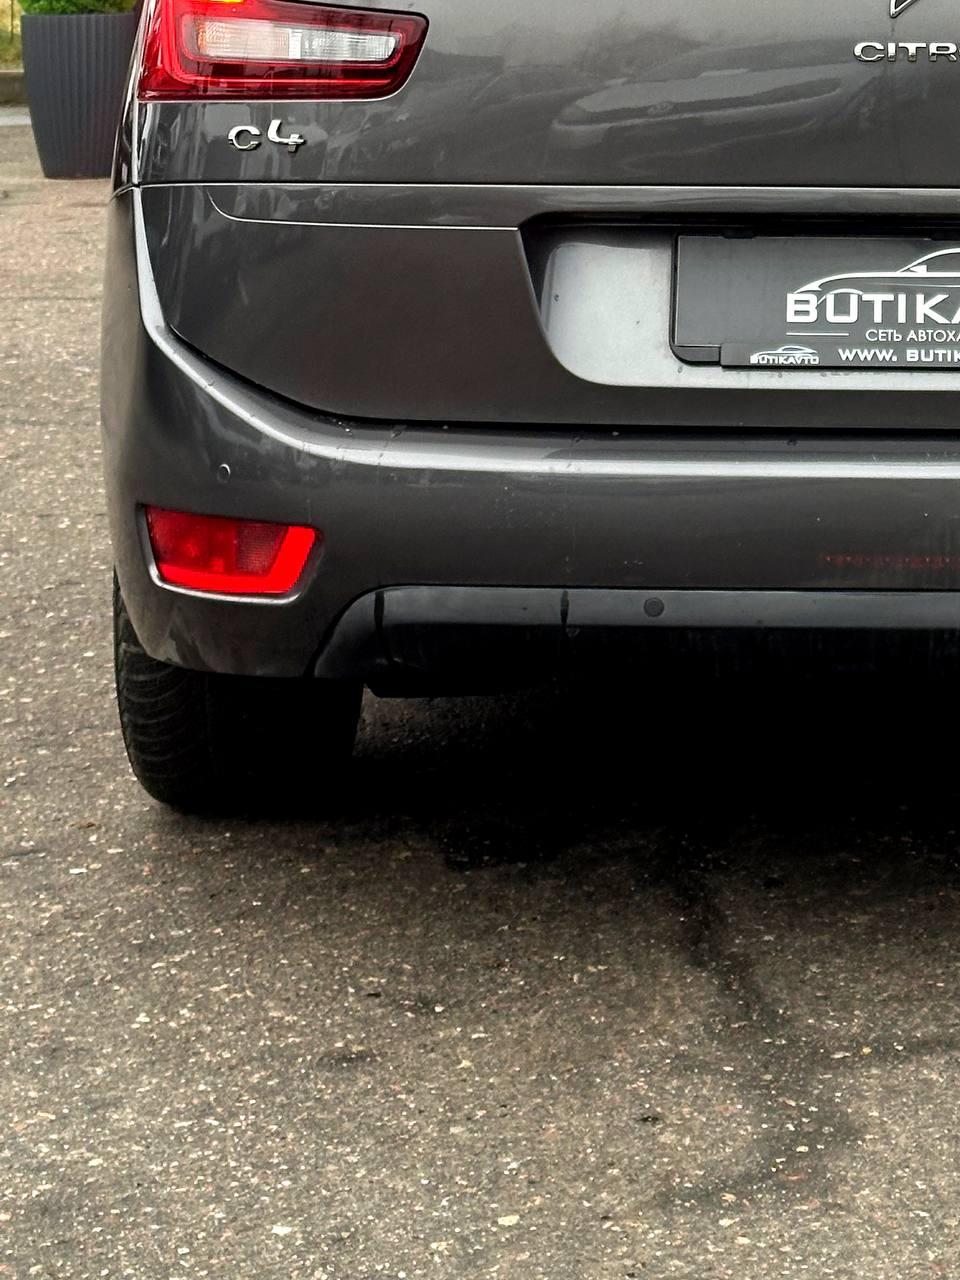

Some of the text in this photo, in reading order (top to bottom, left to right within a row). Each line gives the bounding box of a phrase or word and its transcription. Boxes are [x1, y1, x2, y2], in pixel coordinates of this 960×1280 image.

[228, 119, 305, 152] C4
[865, 329, 902, 342] СЕТЬ
[750, 354, 820, 365] BUTIKAVTO
